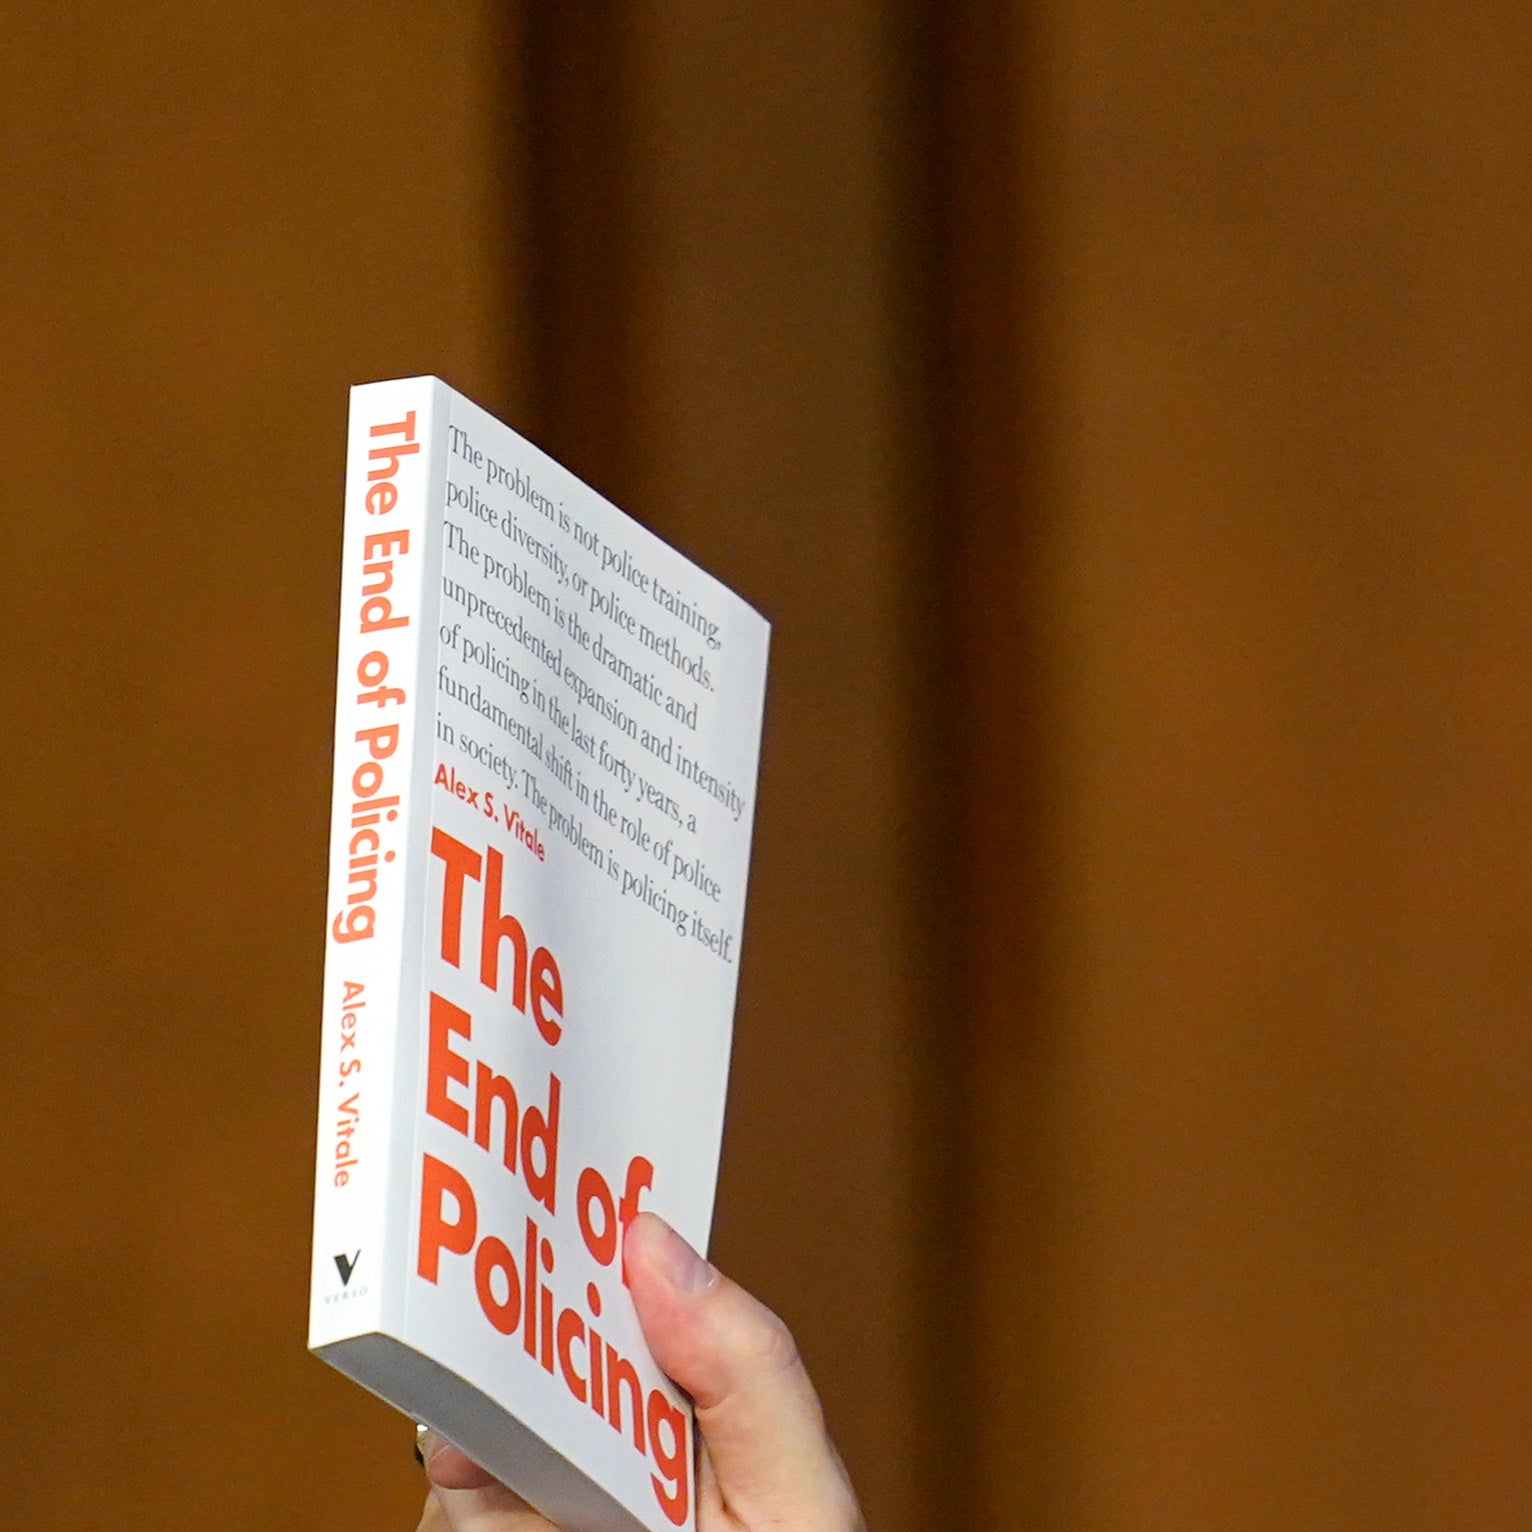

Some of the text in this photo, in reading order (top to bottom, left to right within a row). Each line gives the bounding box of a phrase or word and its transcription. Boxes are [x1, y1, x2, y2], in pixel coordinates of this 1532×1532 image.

[443, 520, 698, 731] The problem is the dramatic and
[446, 480, 715, 692] police diversity, or police methods.
[449, 425, 721, 650] The problem is not police training,
[332, 411, 420, 945] The End of Policing
[438, 664, 721, 902] fundamental shift in the role of police
[440, 623, 697, 834] of policing in the last forty years, a
[443, 576, 747, 822] unprecedented expansion and intensity
[434, 763, 545, 862] Alex S. Vitale
[437, 712, 733, 964] in society. The problem is policing itself.
[431, 826, 564, 1047] The
[334, 980, 366, 1188] Alex S. Vitale
[426, 991, 654, 1289] End of
[416, 1152, 690, 1527] Policing
